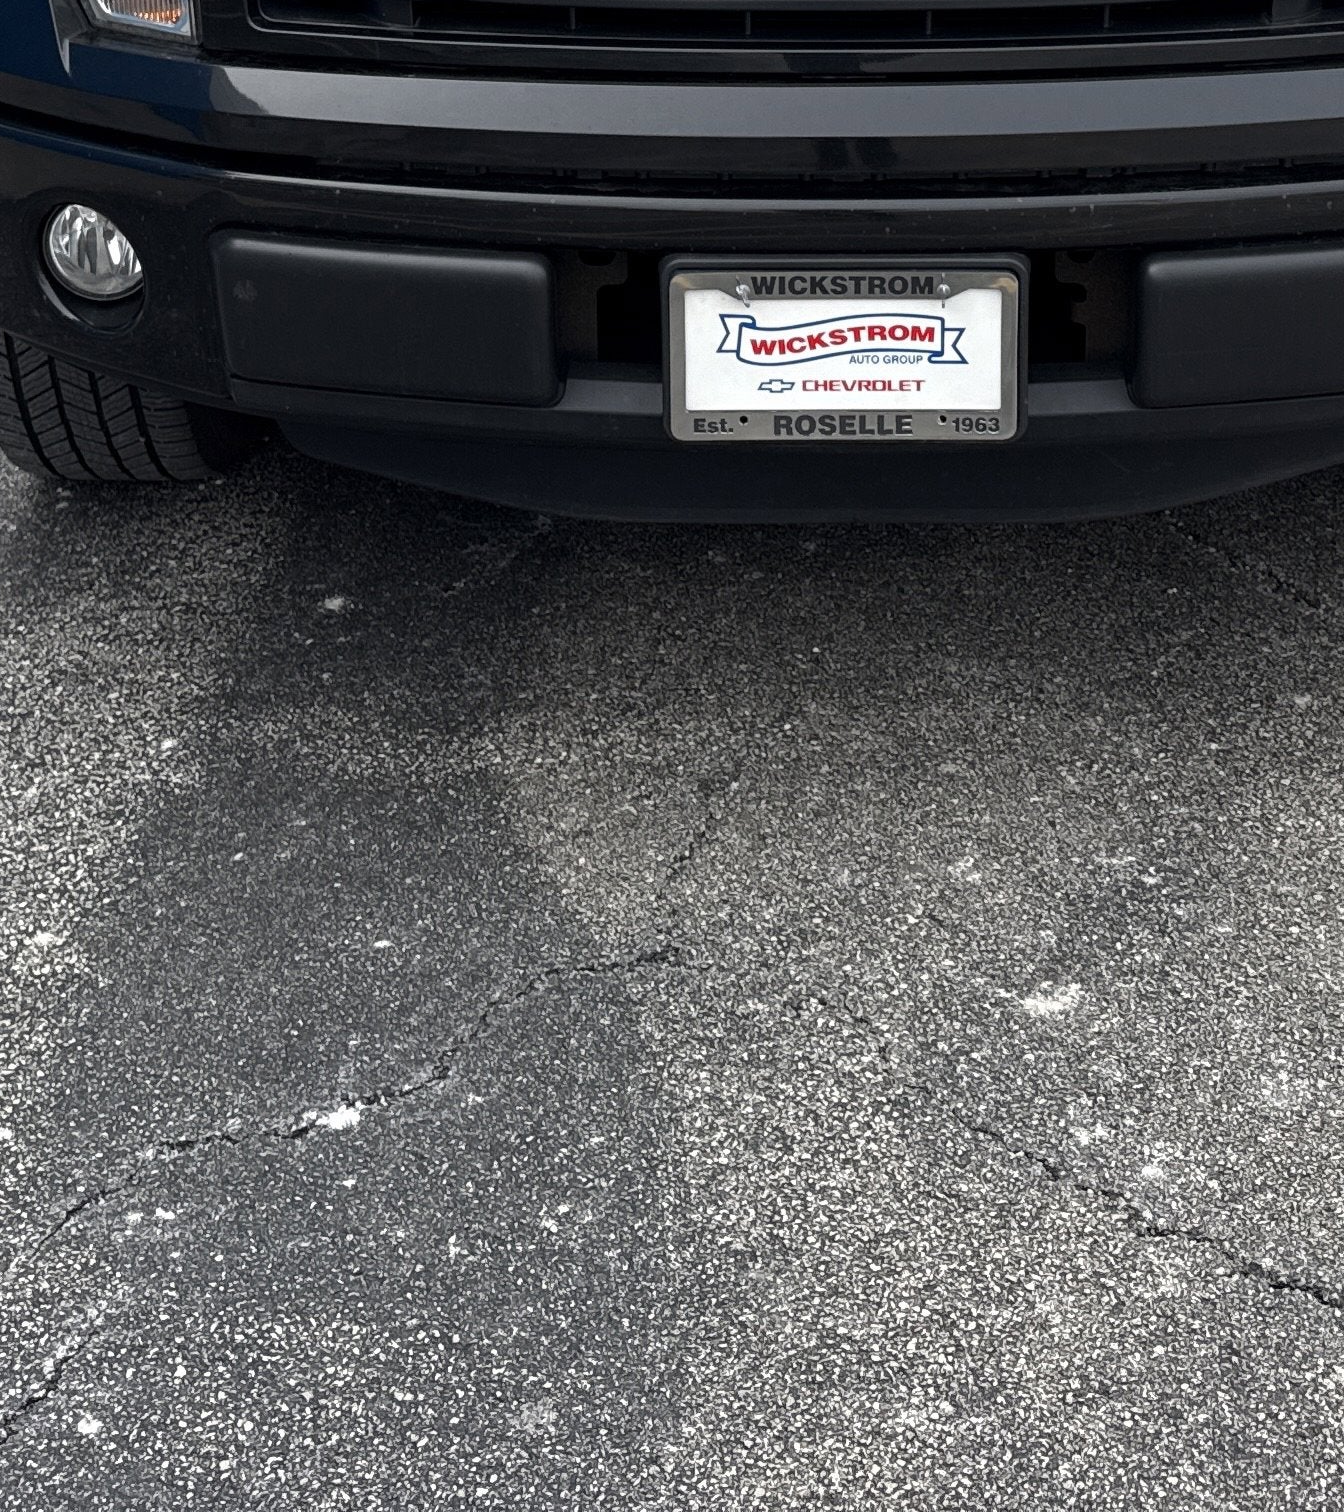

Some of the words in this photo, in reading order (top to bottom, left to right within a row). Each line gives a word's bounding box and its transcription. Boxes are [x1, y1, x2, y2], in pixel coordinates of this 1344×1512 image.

[752, 275, 935, 296] WICKSTROM
[750, 324, 936, 356] WICKSTROM
[849, 355, 880, 365] AUTO
[882, 355, 924, 365] GROUP
[802, 379, 926, 392] CHEVROLET
[693, 417, 735, 434] Est.
[773, 415, 914, 436] ROSELLE
[951, 417, 1001, 434] 1963
